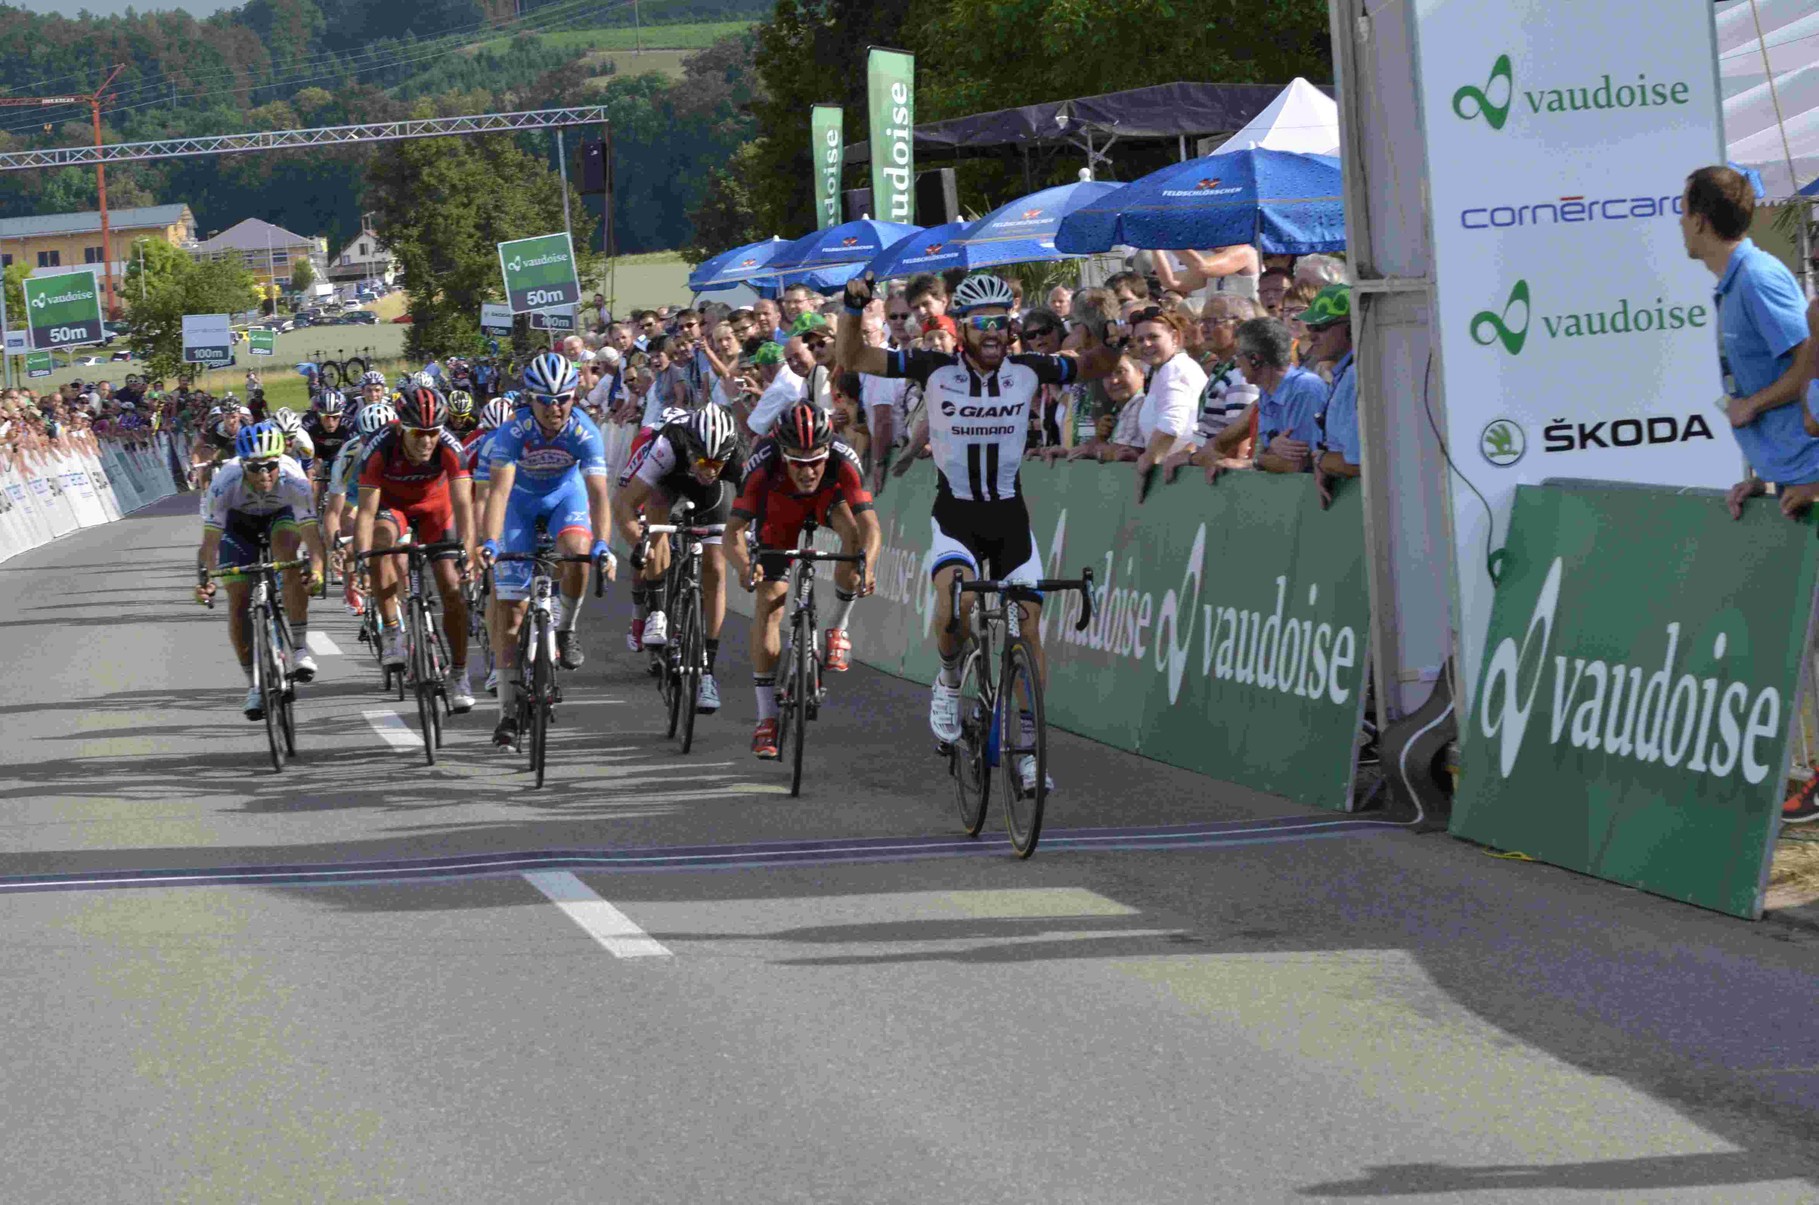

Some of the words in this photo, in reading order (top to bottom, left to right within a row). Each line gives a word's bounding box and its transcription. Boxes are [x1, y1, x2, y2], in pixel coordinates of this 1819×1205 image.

[1524, 75, 1689, 114] vaudoise
[884, 82, 909, 225] udoise
[523, 252, 569, 268] vaudoise
[46, 290, 95, 305] vaudoise
[527, 289, 564, 305] 50m
[1542, 299, 1707, 339] vaudoise
[49, 327, 88, 343] 50m
[193, 348, 224, 359] 100m
[959, 402, 1025, 418] GIANT
[951, 425, 1015, 436] SHIMANO
[1544, 413, 1714, 453] ŠKODA
[1202, 575, 1356, 705] vaudoise
[1550, 621, 1781, 785] vaudoise
